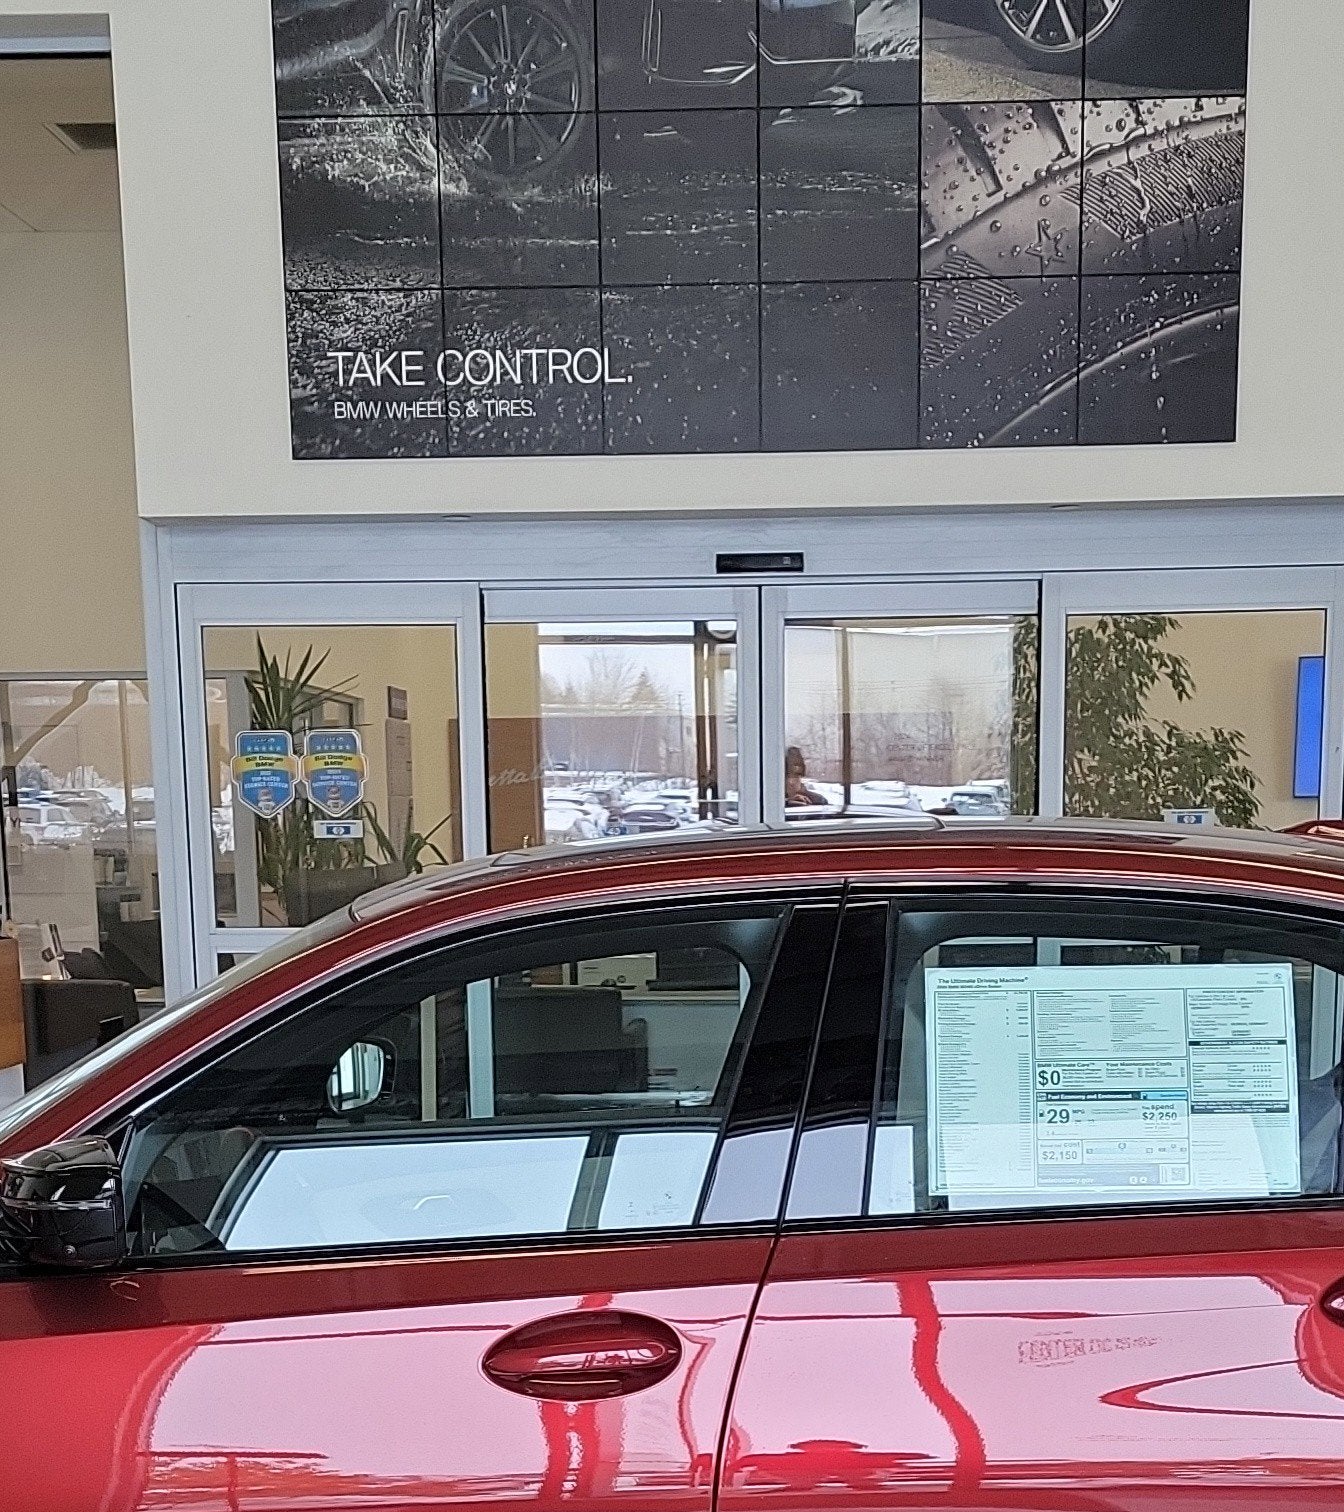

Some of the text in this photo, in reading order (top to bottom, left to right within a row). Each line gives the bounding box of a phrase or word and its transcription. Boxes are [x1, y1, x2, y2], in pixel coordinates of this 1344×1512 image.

[327, 347, 634, 387] TAKE CONTROL.
[334, 399, 537, 419] BMW WHEELS & TIRES.
[1038, 1070, 1061, 1087] $0
[1046, 1108, 1070, 1125] 29
[1042, 1150, 1078, 1162] $2,150
